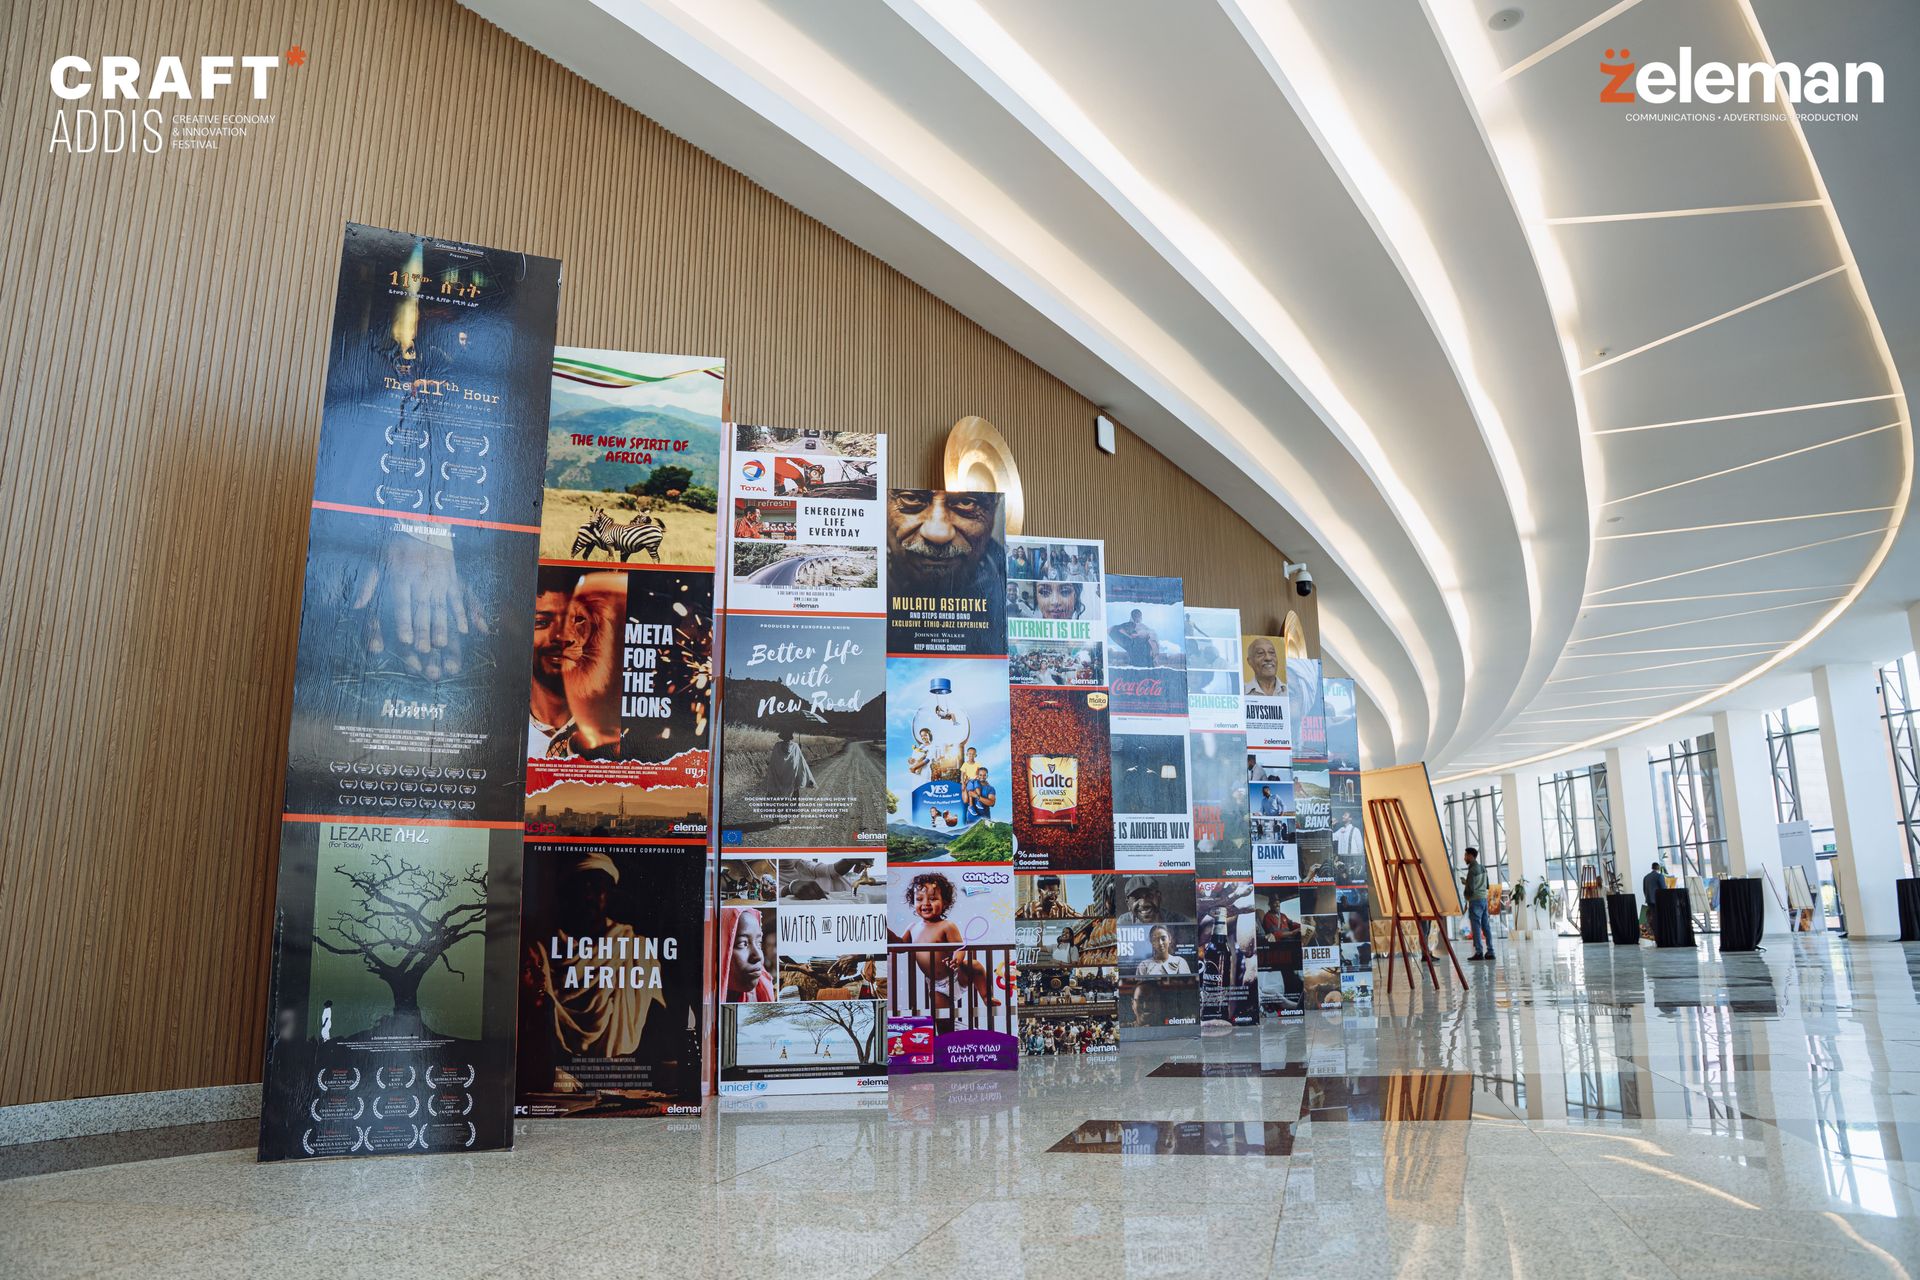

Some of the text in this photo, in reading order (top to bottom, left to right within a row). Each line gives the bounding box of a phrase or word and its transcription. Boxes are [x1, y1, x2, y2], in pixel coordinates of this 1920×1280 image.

[384, 376, 410, 391] The
[463, 388, 500, 404] Hour
[465, 404, 493, 413] Movie
[571, 433, 689, 453] THE NEW SPIRIT OF
[605, 450, 652, 465] AFRICA
[740, 484, 767, 492] TOTAL
[804, 506, 865, 517] ENERGIZING
[824, 518, 845, 527] LIFE
[809, 528, 860, 537] EVERYDAY
[892, 596, 987, 612] MULATU ASTATKE
[938, 612, 955, 620] AHEAD
[891, 620, 989, 629] EXCLUSIVE ETHIO-JAZZ EXPERIENCE
[1009, 619, 1091, 640] NTERNET IS LIFE
[624, 623, 673, 645] META
[624, 647, 657, 669] FOR
[747, 639, 863, 667] Better Life
[622, 671, 654, 693] THE
[785, 664, 832, 687] with
[1111, 678, 1164, 697] Coca-Cola
[621, 696, 672, 718] LIONS
[757, 689, 865, 718] New Road
[1188, 695, 1239, 709] CHANGERS
[1246, 705, 1283, 720] ABYSSINIA
[1032, 774, 1073, 788] Malta
[923, 784, 948, 797] YES
[525, 822, 556, 833] AGEO
[1305, 815, 1330, 828] BANK
[330, 826, 393, 842] LEZARE
[1118, 822, 1190, 840] IS ANOTHER WAY
[554, 845, 606, 853] INTERNATIONAL
[1257, 845, 1285, 860] BANK
[963, 872, 1009, 884] canbebe
[780, 914, 817, 943] WATER
[1015, 926, 1043, 946] GUS
[1117, 928, 1145, 942] ATING
[551, 936, 678, 960] LIGHTING
[1312, 948, 1331, 959] BEER
[1016, 947, 1041, 965] ALT
[564, 966, 663, 989] AFRICA
[888, 1023, 913, 1031] anbebe
[720, 1081, 753, 1092] unicef
[857, 1078, 888, 1087] zelema
[515, 1105, 528, 1114] FC
